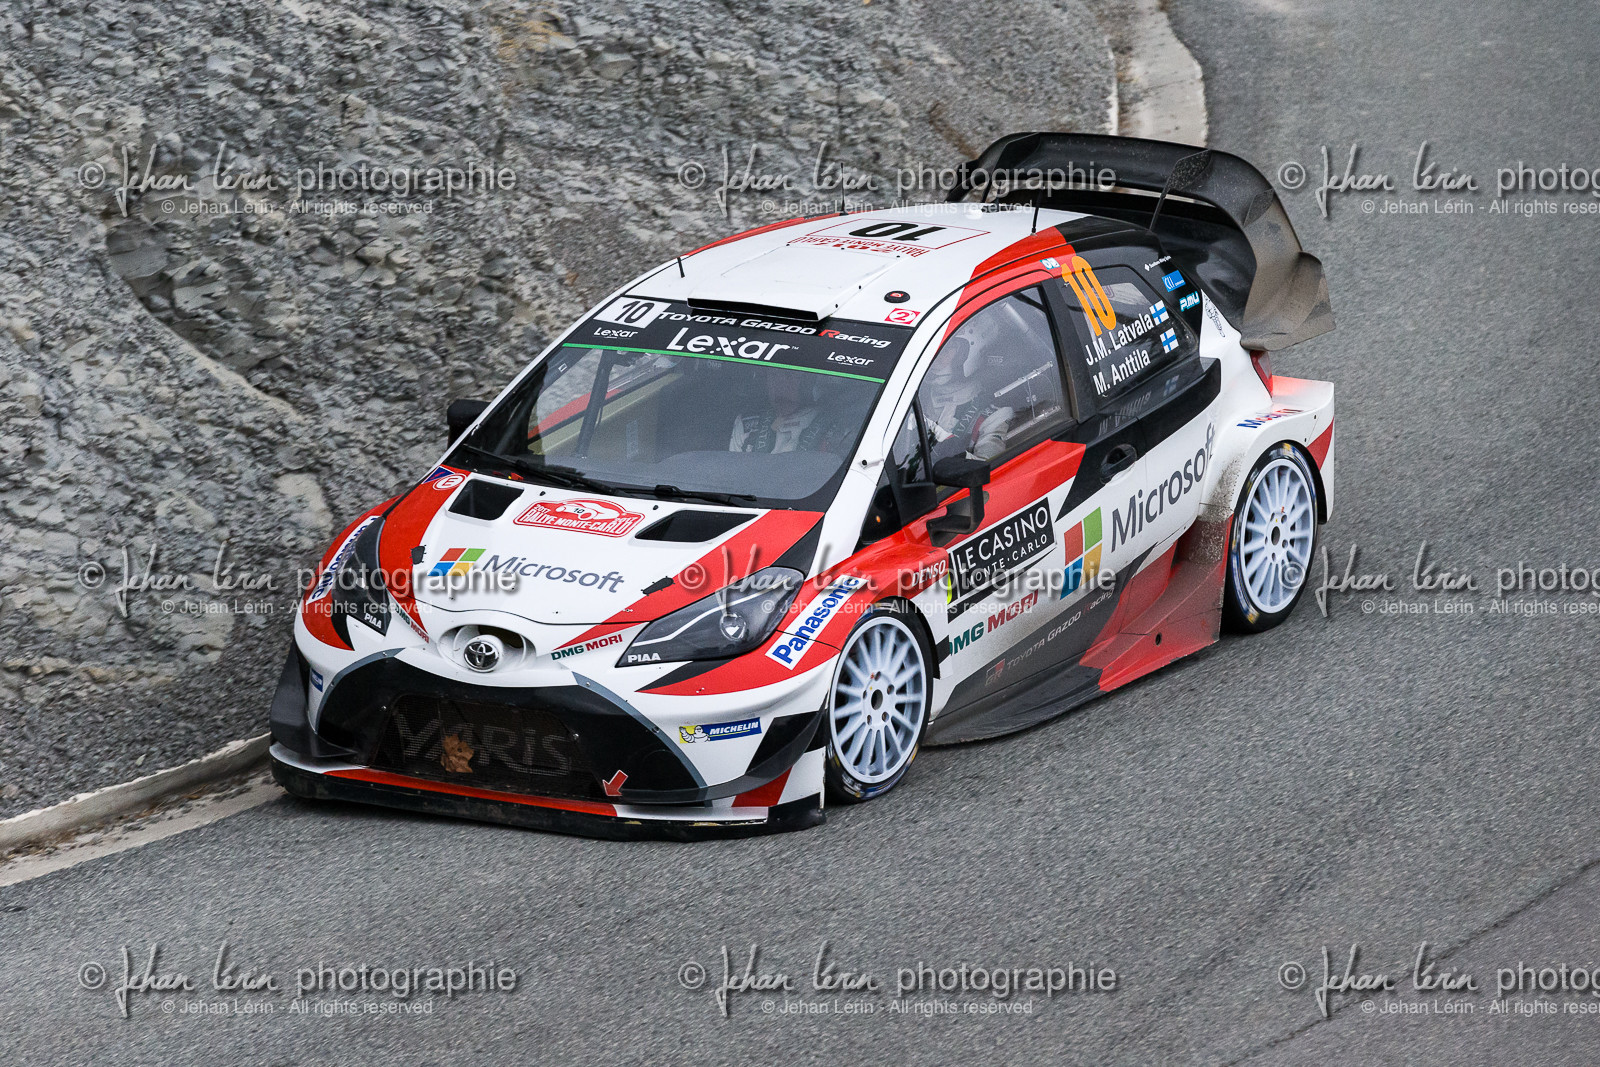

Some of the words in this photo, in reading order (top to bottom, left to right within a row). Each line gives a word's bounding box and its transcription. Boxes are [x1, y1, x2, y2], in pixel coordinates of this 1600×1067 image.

[849, 222, 948, 241] 10
[614, 300, 655, 324] 10
[1061, 255, 1117, 337] 10
[593, 326, 638, 337] Lexar
[659, 311, 738, 326] TOYOTA
[740, 318, 818, 336] GAZOO
[818, 329, 892, 348] Racing
[1085, 337, 1112, 366] J.M.
[1108, 313, 1154, 351] Latvala
[826, 351, 875, 366] Lexar
[1093, 371, 1111, 395] M.
[1110, 348, 1151, 386] Anttila
[1111, 422, 1215, 553] Microsoft
[520, 509, 559, 523] RALLYE
[956, 546, 977, 575] LE
[978, 506, 1049, 561] CASINO
[481, 554, 625, 594] Microsoft
[911, 559, 946, 588] DENSO
[364, 612, 382, 628] PIAA
[772, 578, 860, 665] Panasonic
[949, 620, 985, 656] MG
[988, 589, 1039, 634] MORI
[1006, 639, 1046, 670] TOYOTA
[1047, 610, 1082, 642] GAZOO
[1084, 588, 1115, 616] Racing
[550, 644, 585, 661] DMG
[585, 633, 623, 651] MORI
[627, 652, 661, 663] PIAA
[709, 721, 759, 735] MICHELIN
